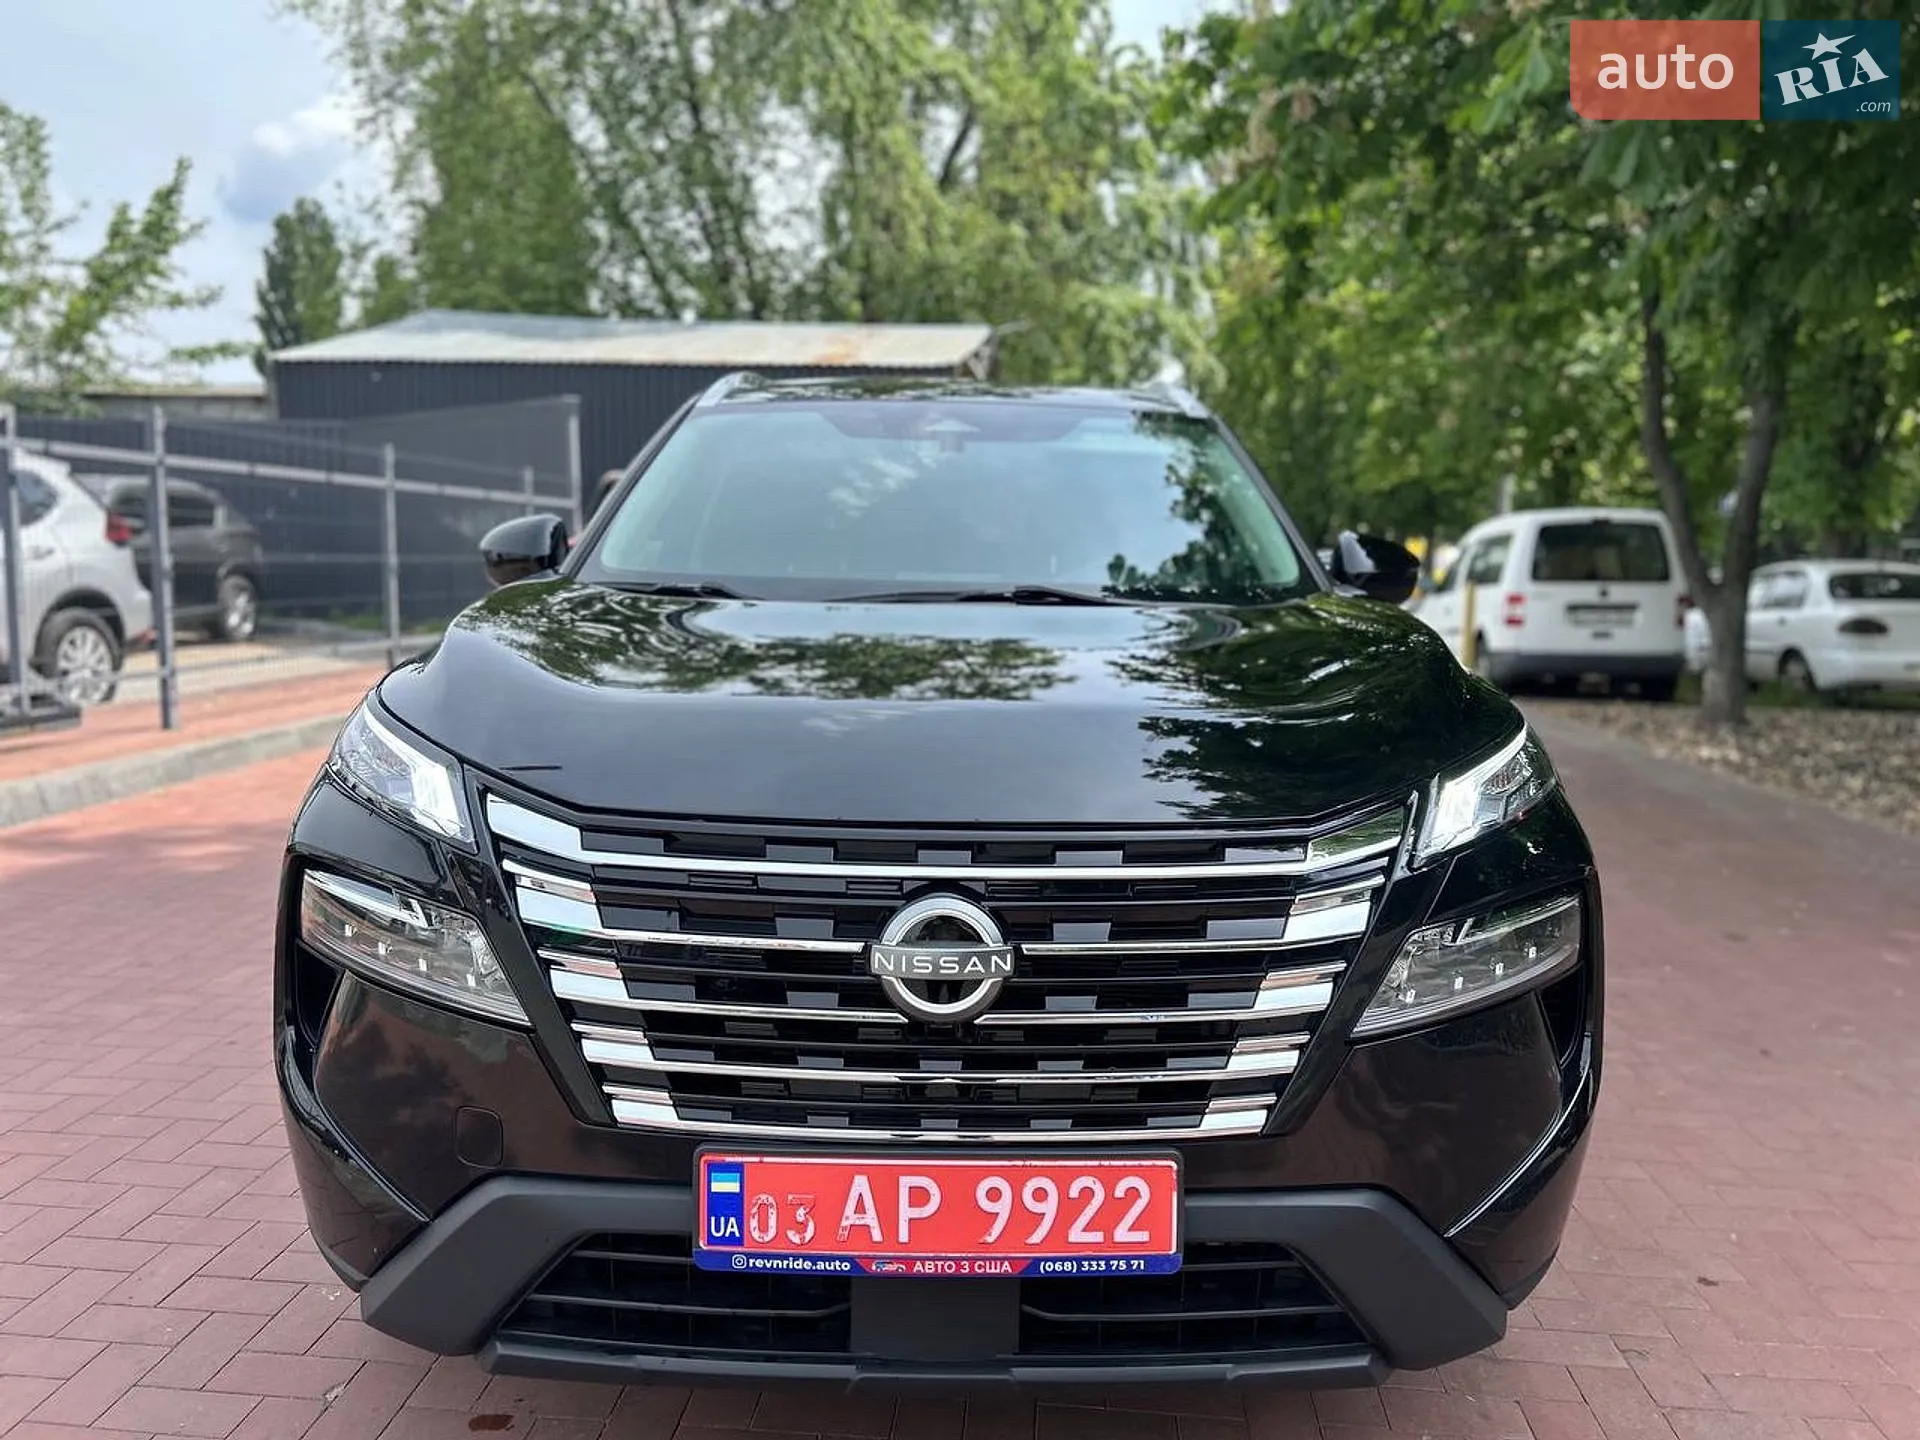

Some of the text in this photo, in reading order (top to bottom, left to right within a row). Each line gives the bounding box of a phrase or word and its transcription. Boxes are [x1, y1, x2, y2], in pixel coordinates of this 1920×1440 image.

[874, 953, 1011, 974] NISSAN
[749, 1174, 1151, 1245] 03 AP 9922
[710, 1216, 741, 1238] UA
[748, 1256, 851, 1271] revnride.auto
[974, 1260, 1013, 1274] США
[1039, 1259, 1145, 1274] (068) 333 75 71
